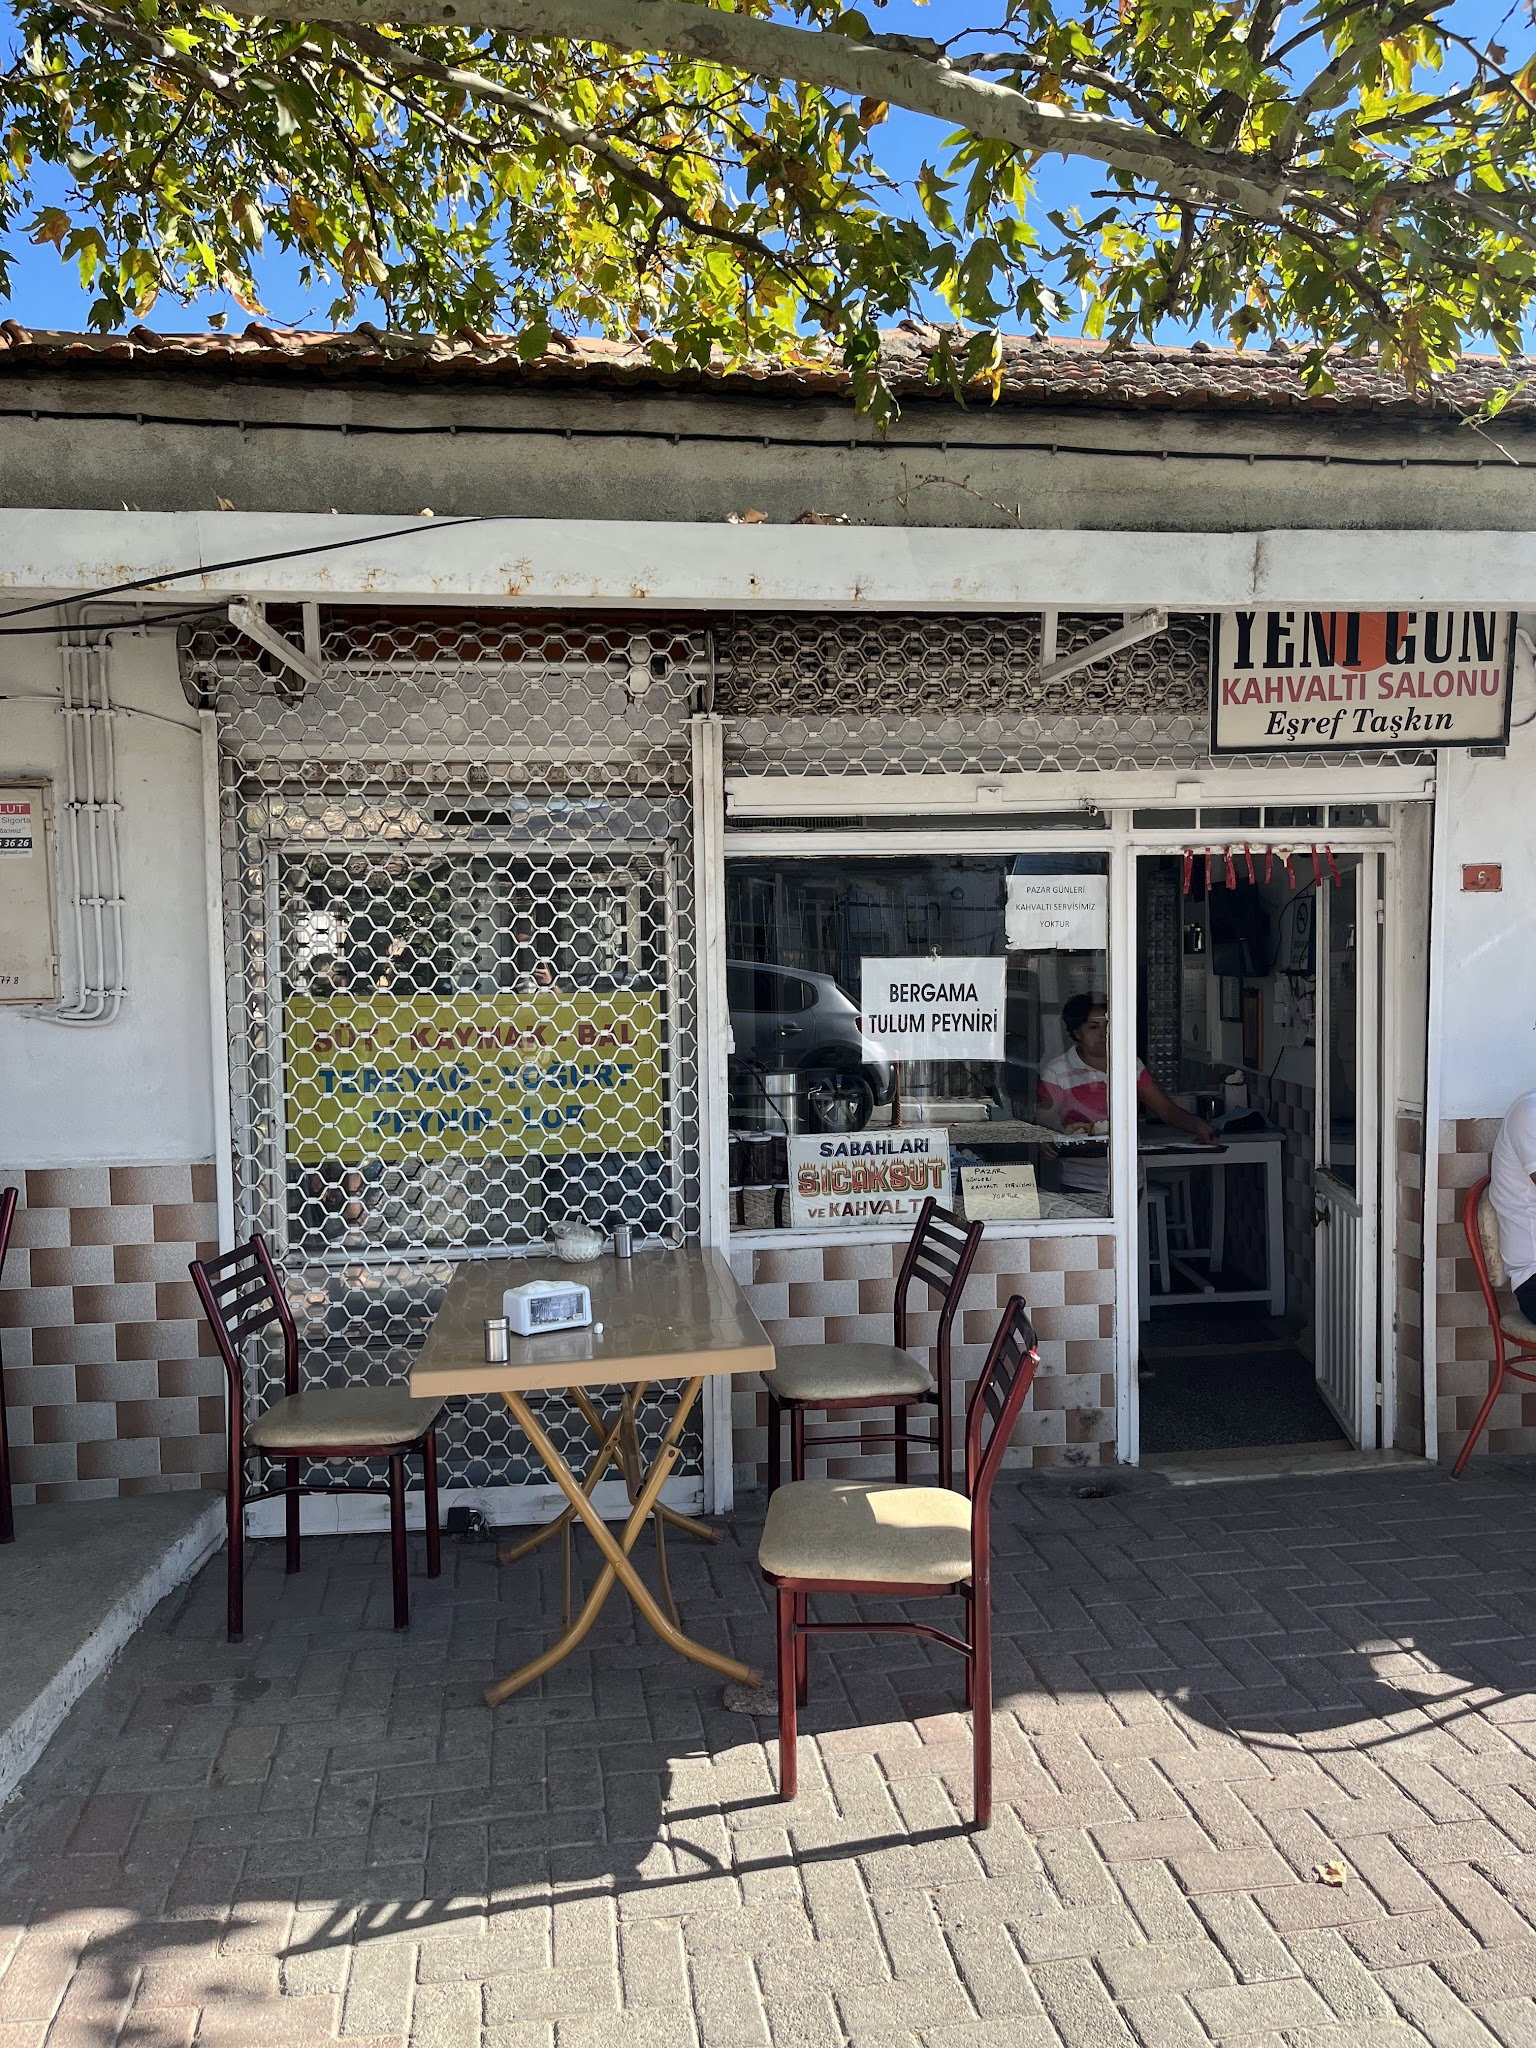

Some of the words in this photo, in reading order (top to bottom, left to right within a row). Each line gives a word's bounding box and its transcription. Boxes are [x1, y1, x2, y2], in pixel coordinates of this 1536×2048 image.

[1222, 674, 1366, 705] KAHVALTI
[1378, 669, 1500, 700] SALONU
[1264, 709, 1347, 741] Eşref
[1353, 707, 1453, 738] Taşkın
[1, 817, 31, 825] Sigorta
[4, 839, 16, 847] 36
[17, 839, 29, 847] 26
[1026, 886, 1051, 894] PAZAR
[1052, 884, 1086, 894] GÜNLERİ
[1015, 903, 1052, 911] KAHVALTI
[1053, 902, 1096, 911] SERVİSİMİZ
[1040, 920, 1070, 928] YOKTUR
[889, 983, 978, 1002] BERGAMA
[869, 1013, 925, 1033] TULUM
[931, 1008, 998, 1032] PEYNİRİ
[313, 1022, 379, 1053] SÜT
[410, 1025, 548, 1051] KAYMAK
[578, 1024, 638, 1047] BAL
[319, 1062, 471, 1094] TEREYAĞ
[502, 1060, 633, 1090] YOĞURT
[523, 1105, 586, 1130] LOR
[819, 1138, 930, 1158] SABAHLARI
[974, 1167, 1007, 1175] PAZAR
[828, 1199, 922, 1218] KAHVALT
